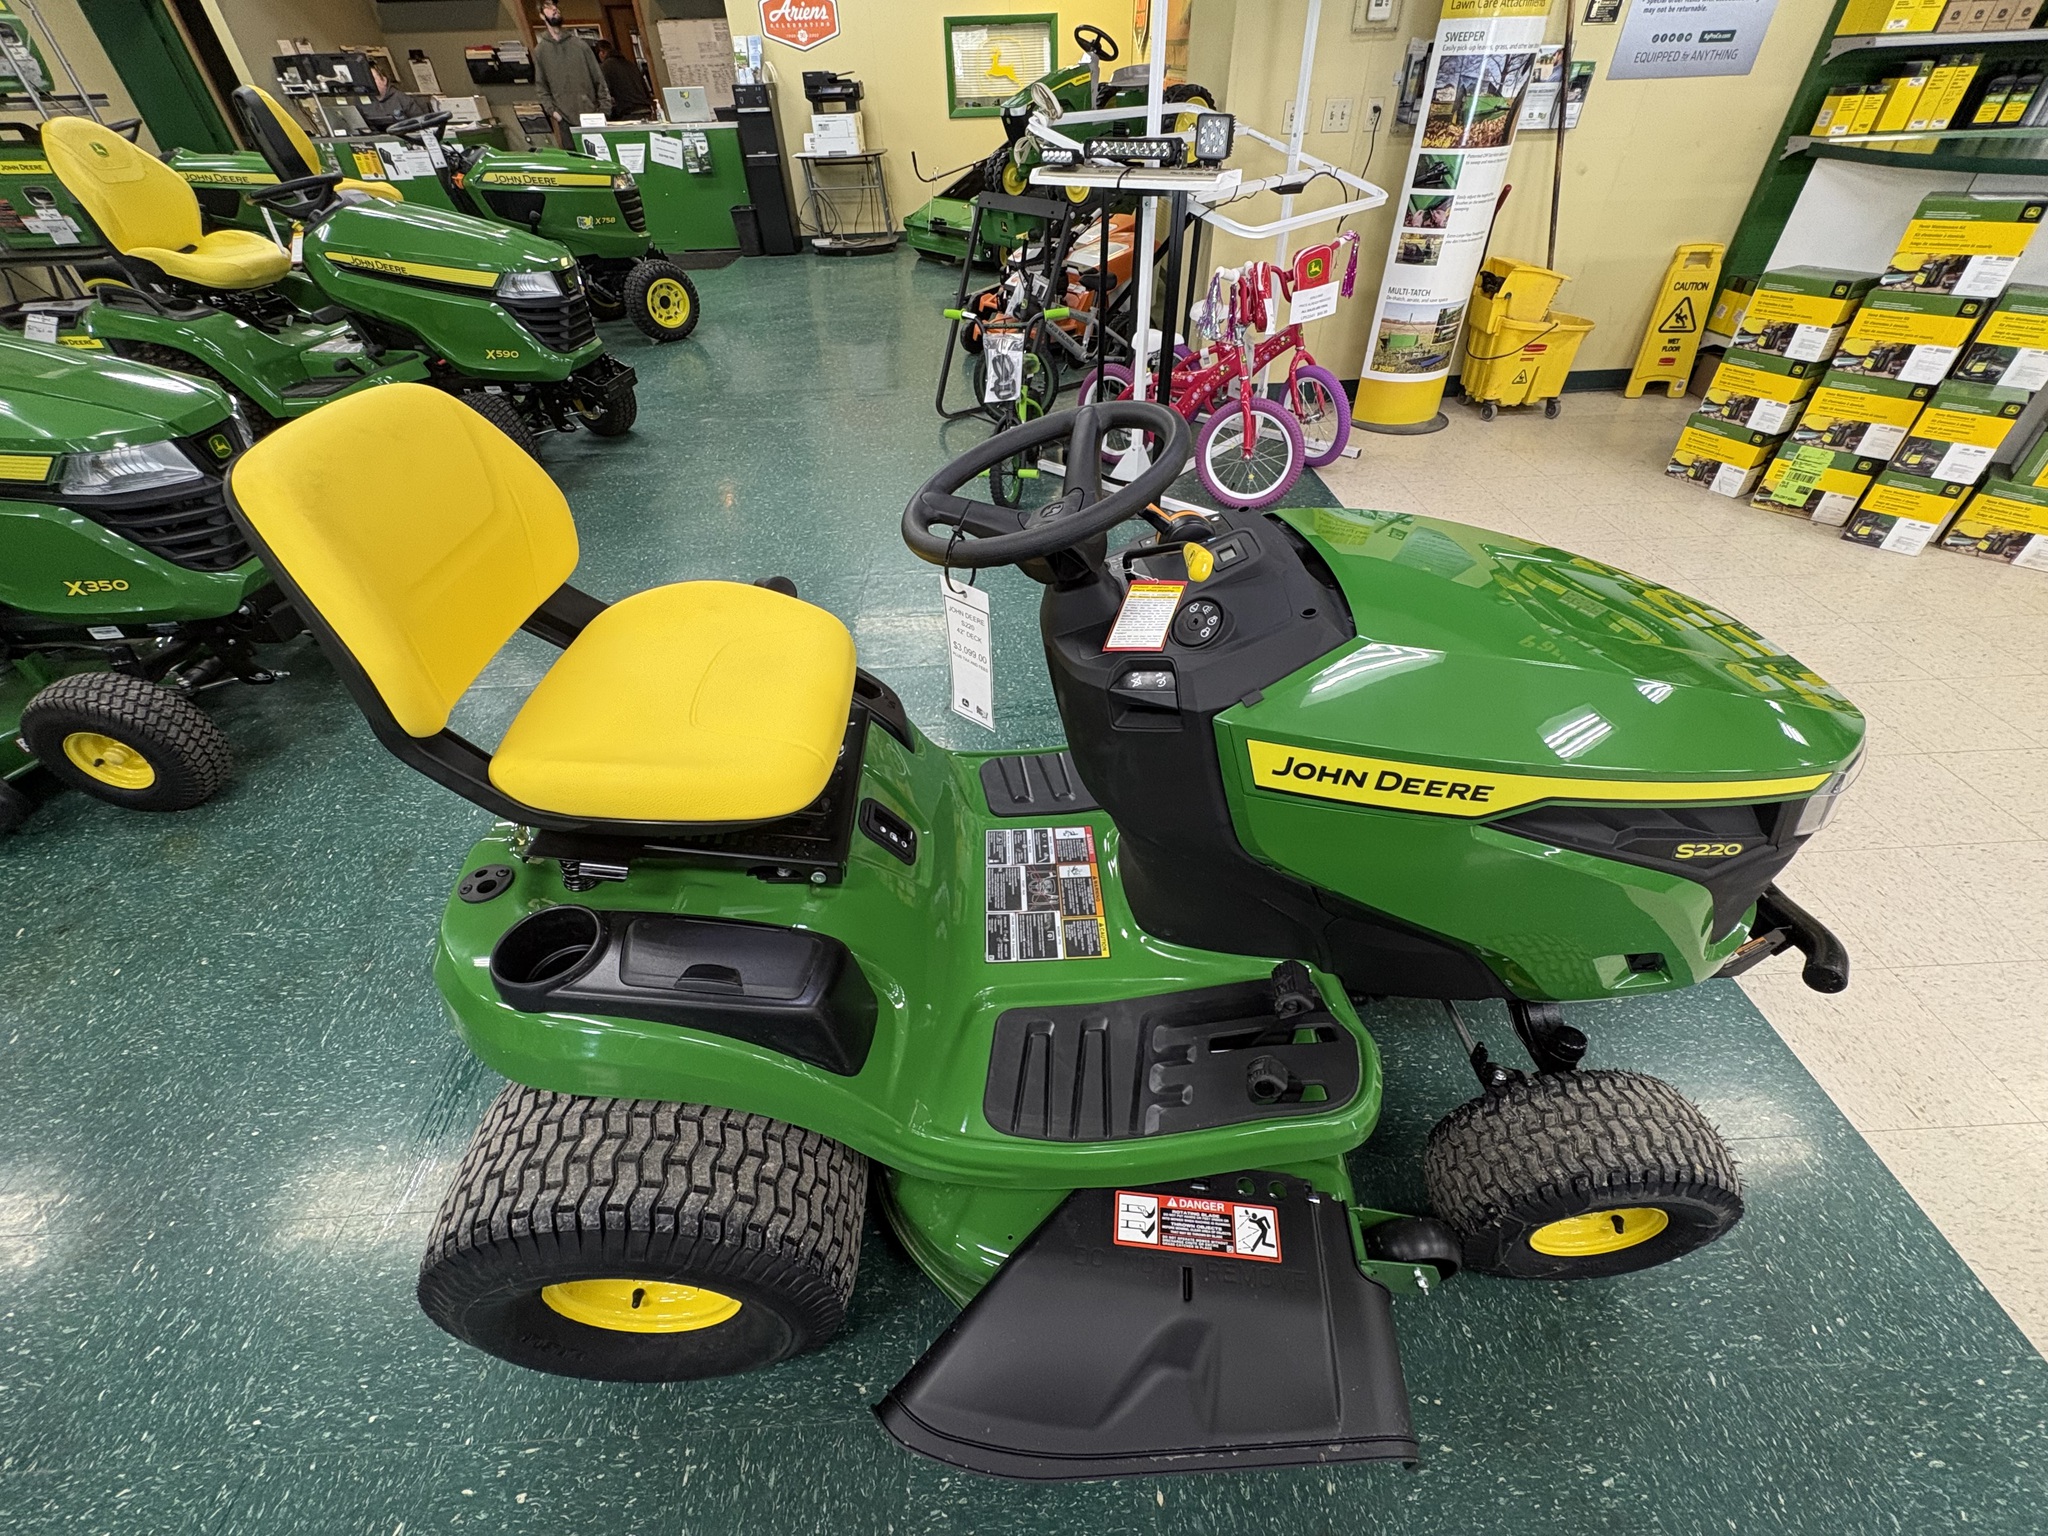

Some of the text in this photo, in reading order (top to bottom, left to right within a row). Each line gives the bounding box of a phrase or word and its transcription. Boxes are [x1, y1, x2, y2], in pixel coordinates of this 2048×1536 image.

[769, 0, 829, 22] Ariens
[1450, 0, 1475, 10] Lawn
[1477, 0, 1498, 8] Care
[1643, 7, 1655, 15] may
[1676, 4, 1707, 12] returnable.
[1444, 31, 1485, 42] SWEEPER
[1442, 44, 1456, 52] Easily
[1456, 44, 1467, 52] pick
[1494, 44, 1508, 52] grass,
[1634, 51, 1680, 63] EQUIPPED
[1690, 48, 1739, 61] ANYTHING
[184, 172, 250, 184] JOHN DEERE
[494, 174, 557, 185] JOHN DEERE
[350, 256, 408, 275] JOHN DEERE
[1387, 286, 1432, 297] MULTI-TATCH
[1673, 282, 1710, 291] CAUTION
[485, 349, 520, 360] X590
[62, 579, 129, 596] X350
[948, 606, 985, 627] JOHN DEERE
[961, 620, 975, 632] S220
[966, 631, 982, 644] DECK
[1270, 755, 1496, 803] JOHN DEERE
[1672, 842, 1744, 861] S220
[1099, 928, 1108, 952] CAUTION
[1179, 1198, 1225, 1212] DANGER
